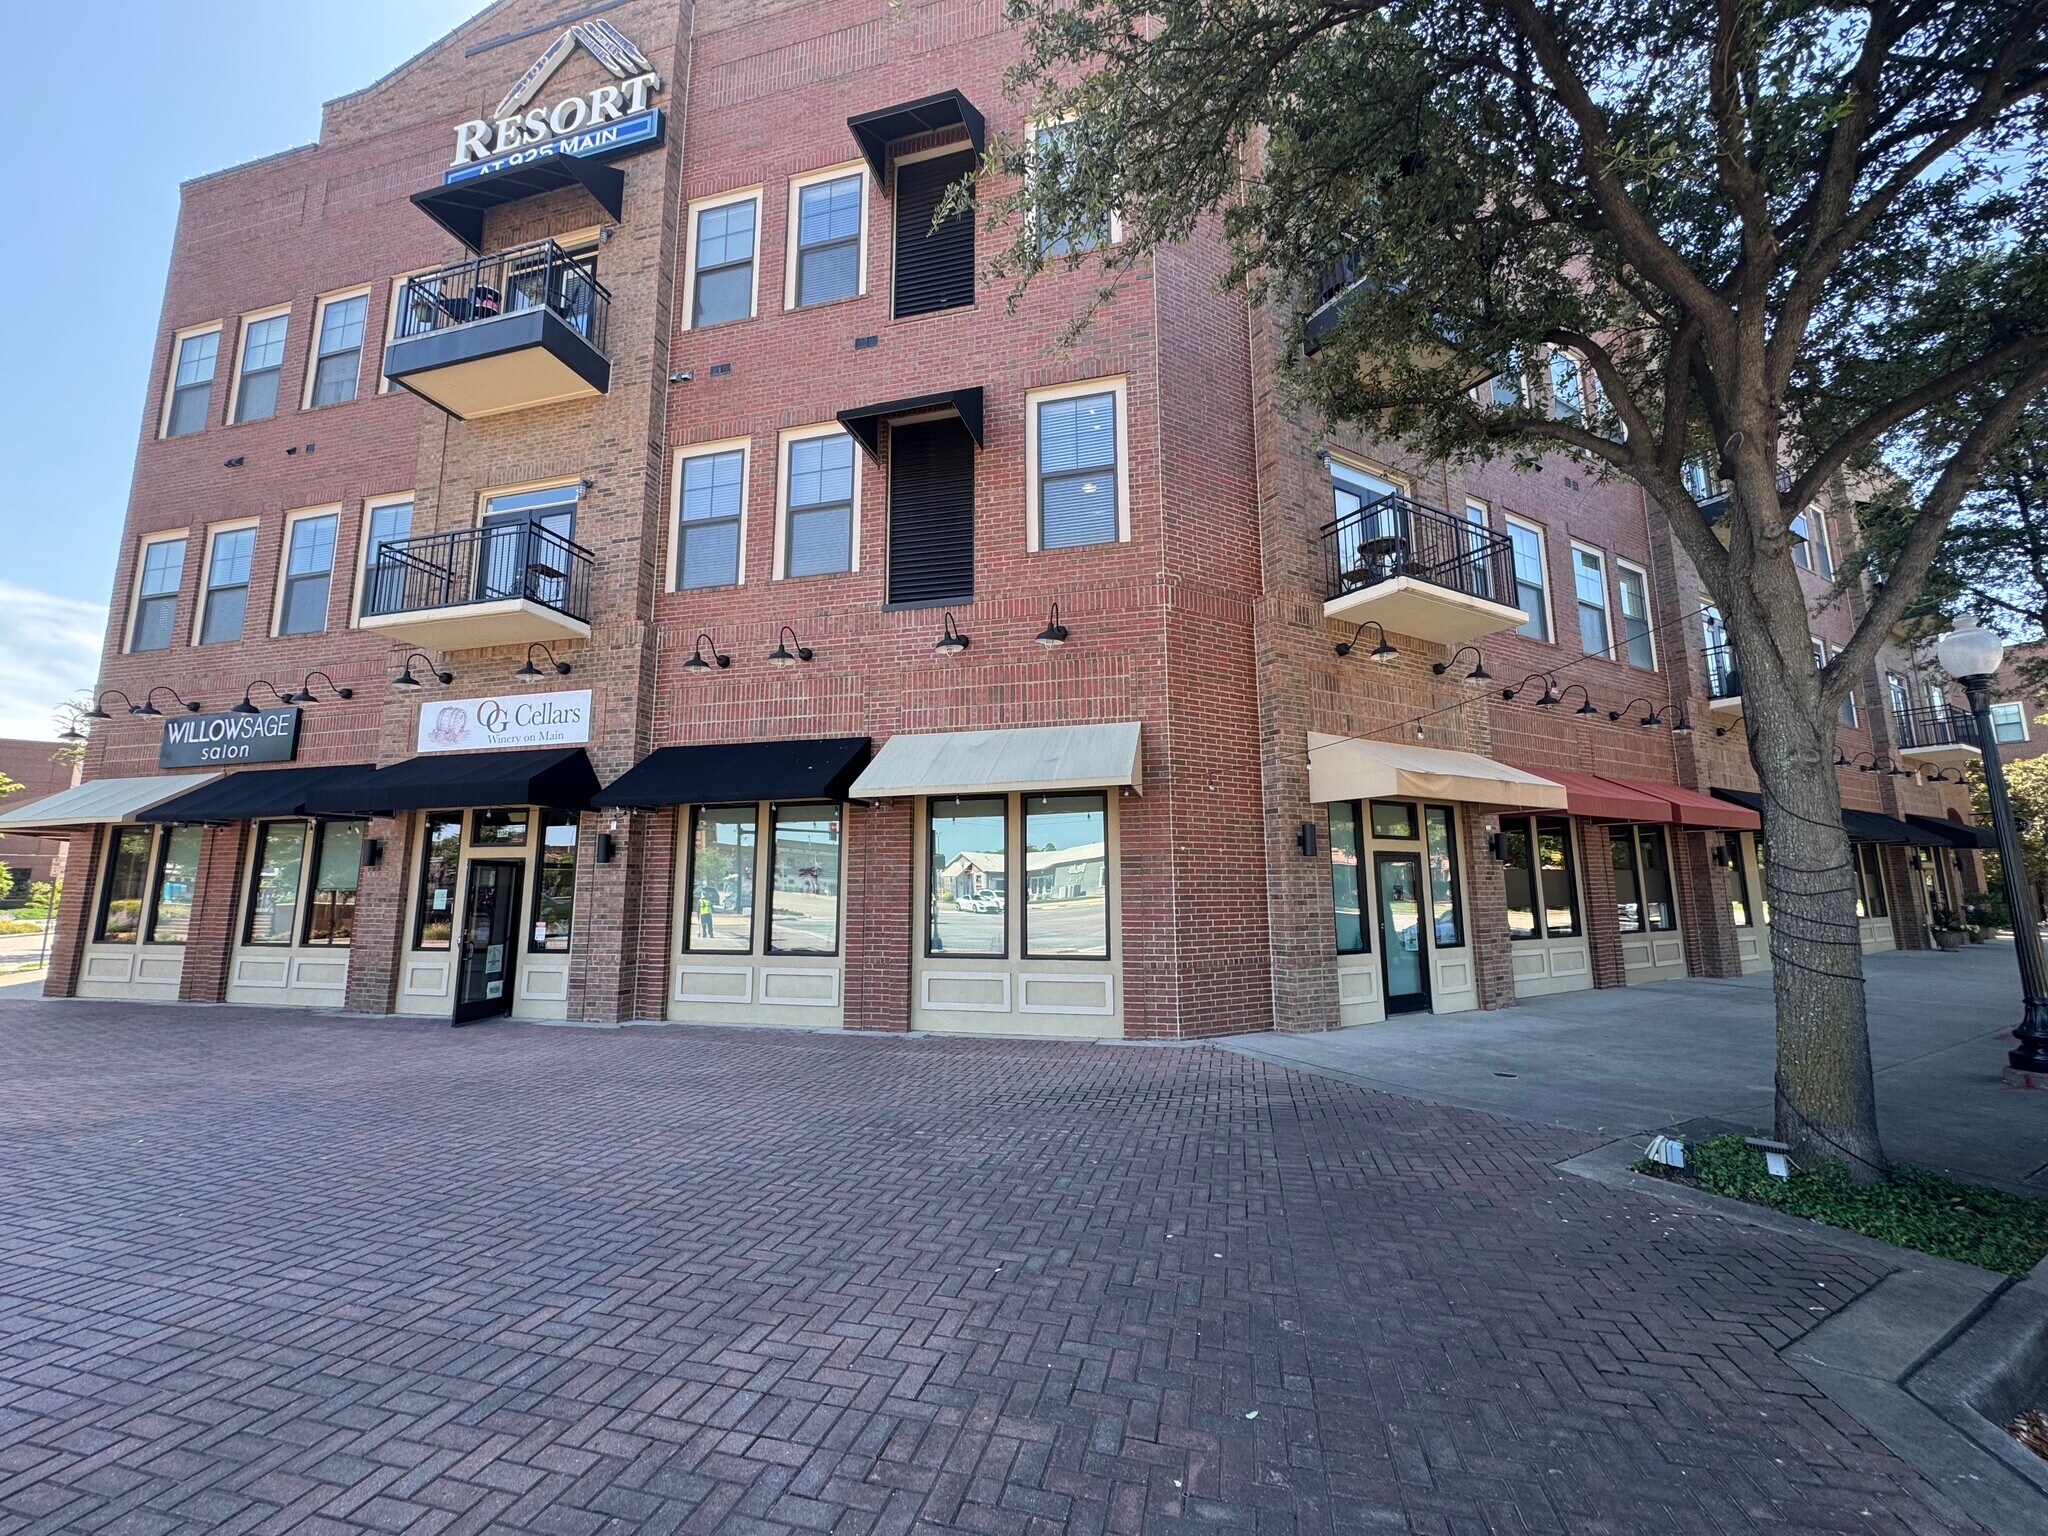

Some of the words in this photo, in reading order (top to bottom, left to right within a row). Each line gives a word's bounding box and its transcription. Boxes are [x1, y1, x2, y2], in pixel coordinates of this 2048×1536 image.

[450, 72, 660, 167] RESORT
[560, 127, 617, 153] MAIN
[515, 702, 581, 727] Cellars
[168, 714, 291, 744] WILLOWSAGE
[487, 734, 521, 745] Winery
[524, 735, 536, 743] on
[539, 731, 564, 742] Main
[201, 744, 250, 760] salon
